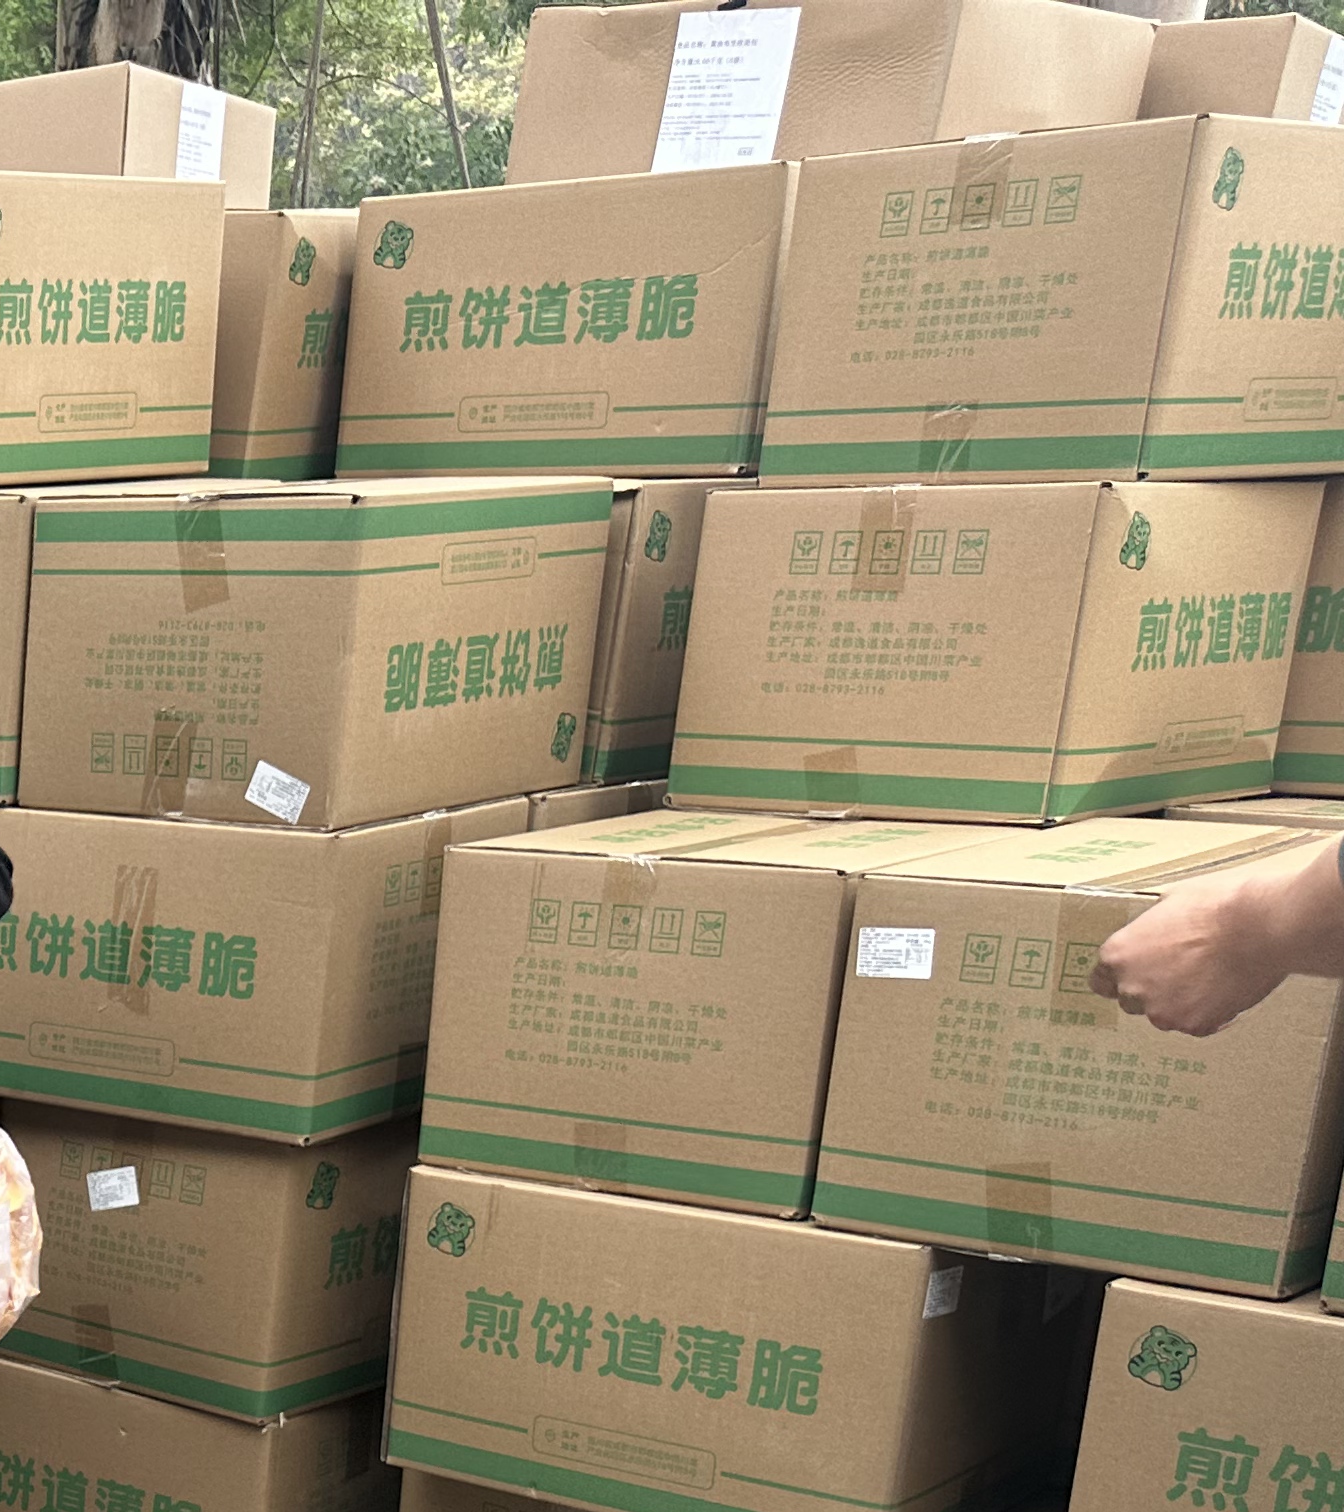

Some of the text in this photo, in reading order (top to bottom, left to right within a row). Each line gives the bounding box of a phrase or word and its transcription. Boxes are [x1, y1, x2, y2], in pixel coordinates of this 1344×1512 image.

[399, 273, 699, 354] 煎饼道薄脆
[1218, 241, 1344, 320] 煎饼道
[384, 623, 568, 713] 煎饼道薄脆
[1131, 591, 1292, 672] 煎饼道薄脆
[459, 1286, 824, 1416] 煎饼道薄脆
